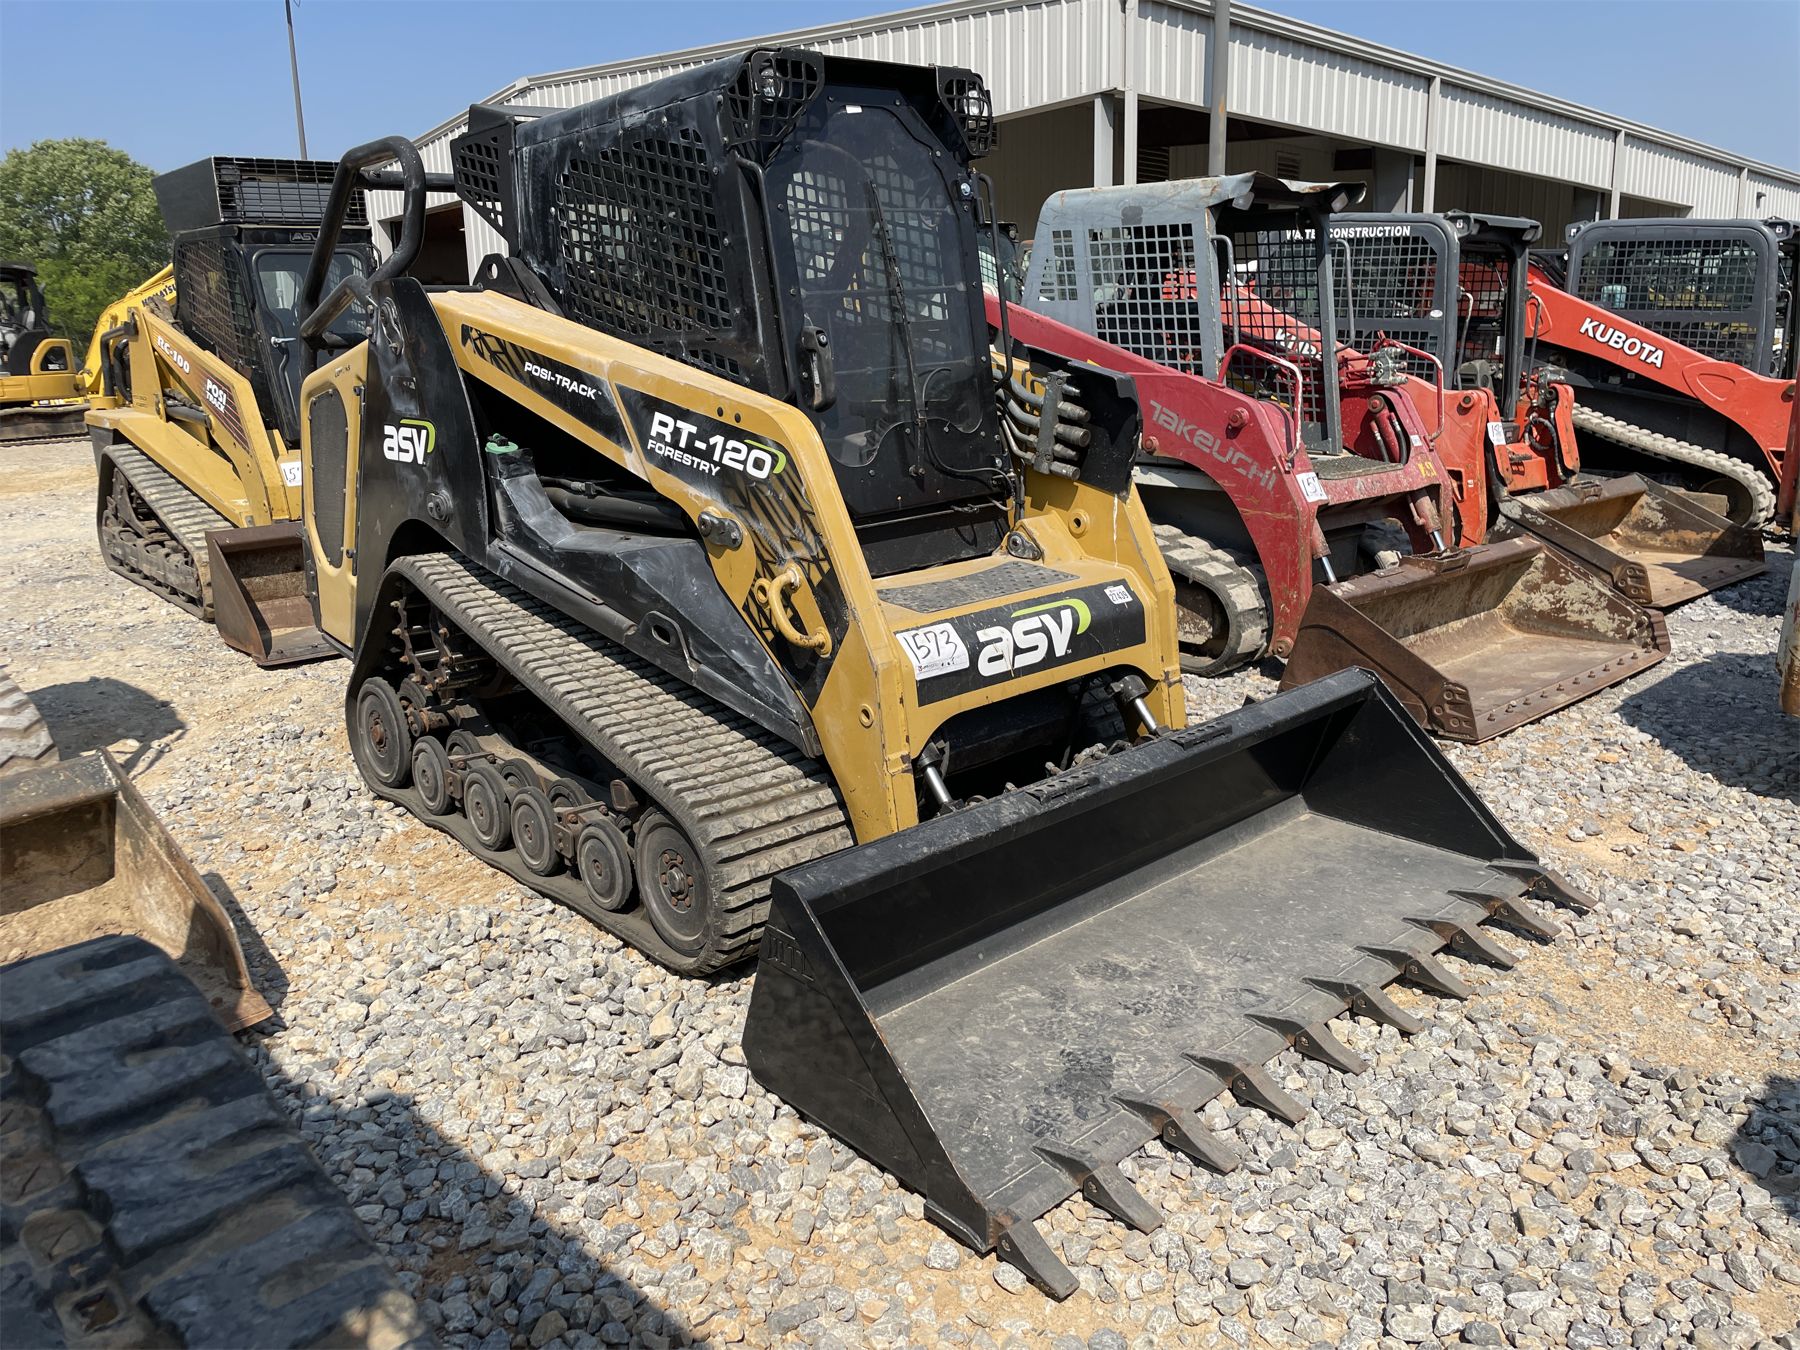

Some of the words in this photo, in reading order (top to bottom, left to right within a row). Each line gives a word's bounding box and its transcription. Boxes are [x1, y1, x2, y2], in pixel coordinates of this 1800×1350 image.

[141, 283, 177, 307] KOATSU
[157, 335, 190, 374] RC-100
[1579, 317, 1664, 369] KUBOTA
[206, 378, 227, 405] POSI
[525, 361, 597, 400] POSI-TRACK
[206, 390, 226, 413] TRACK
[647, 439, 720, 476] FORESTRY
[650, 411, 772, 479] RT-120
[1109, 591, 1129, 601] 27439
[903, 630, 957, 664] 1573
